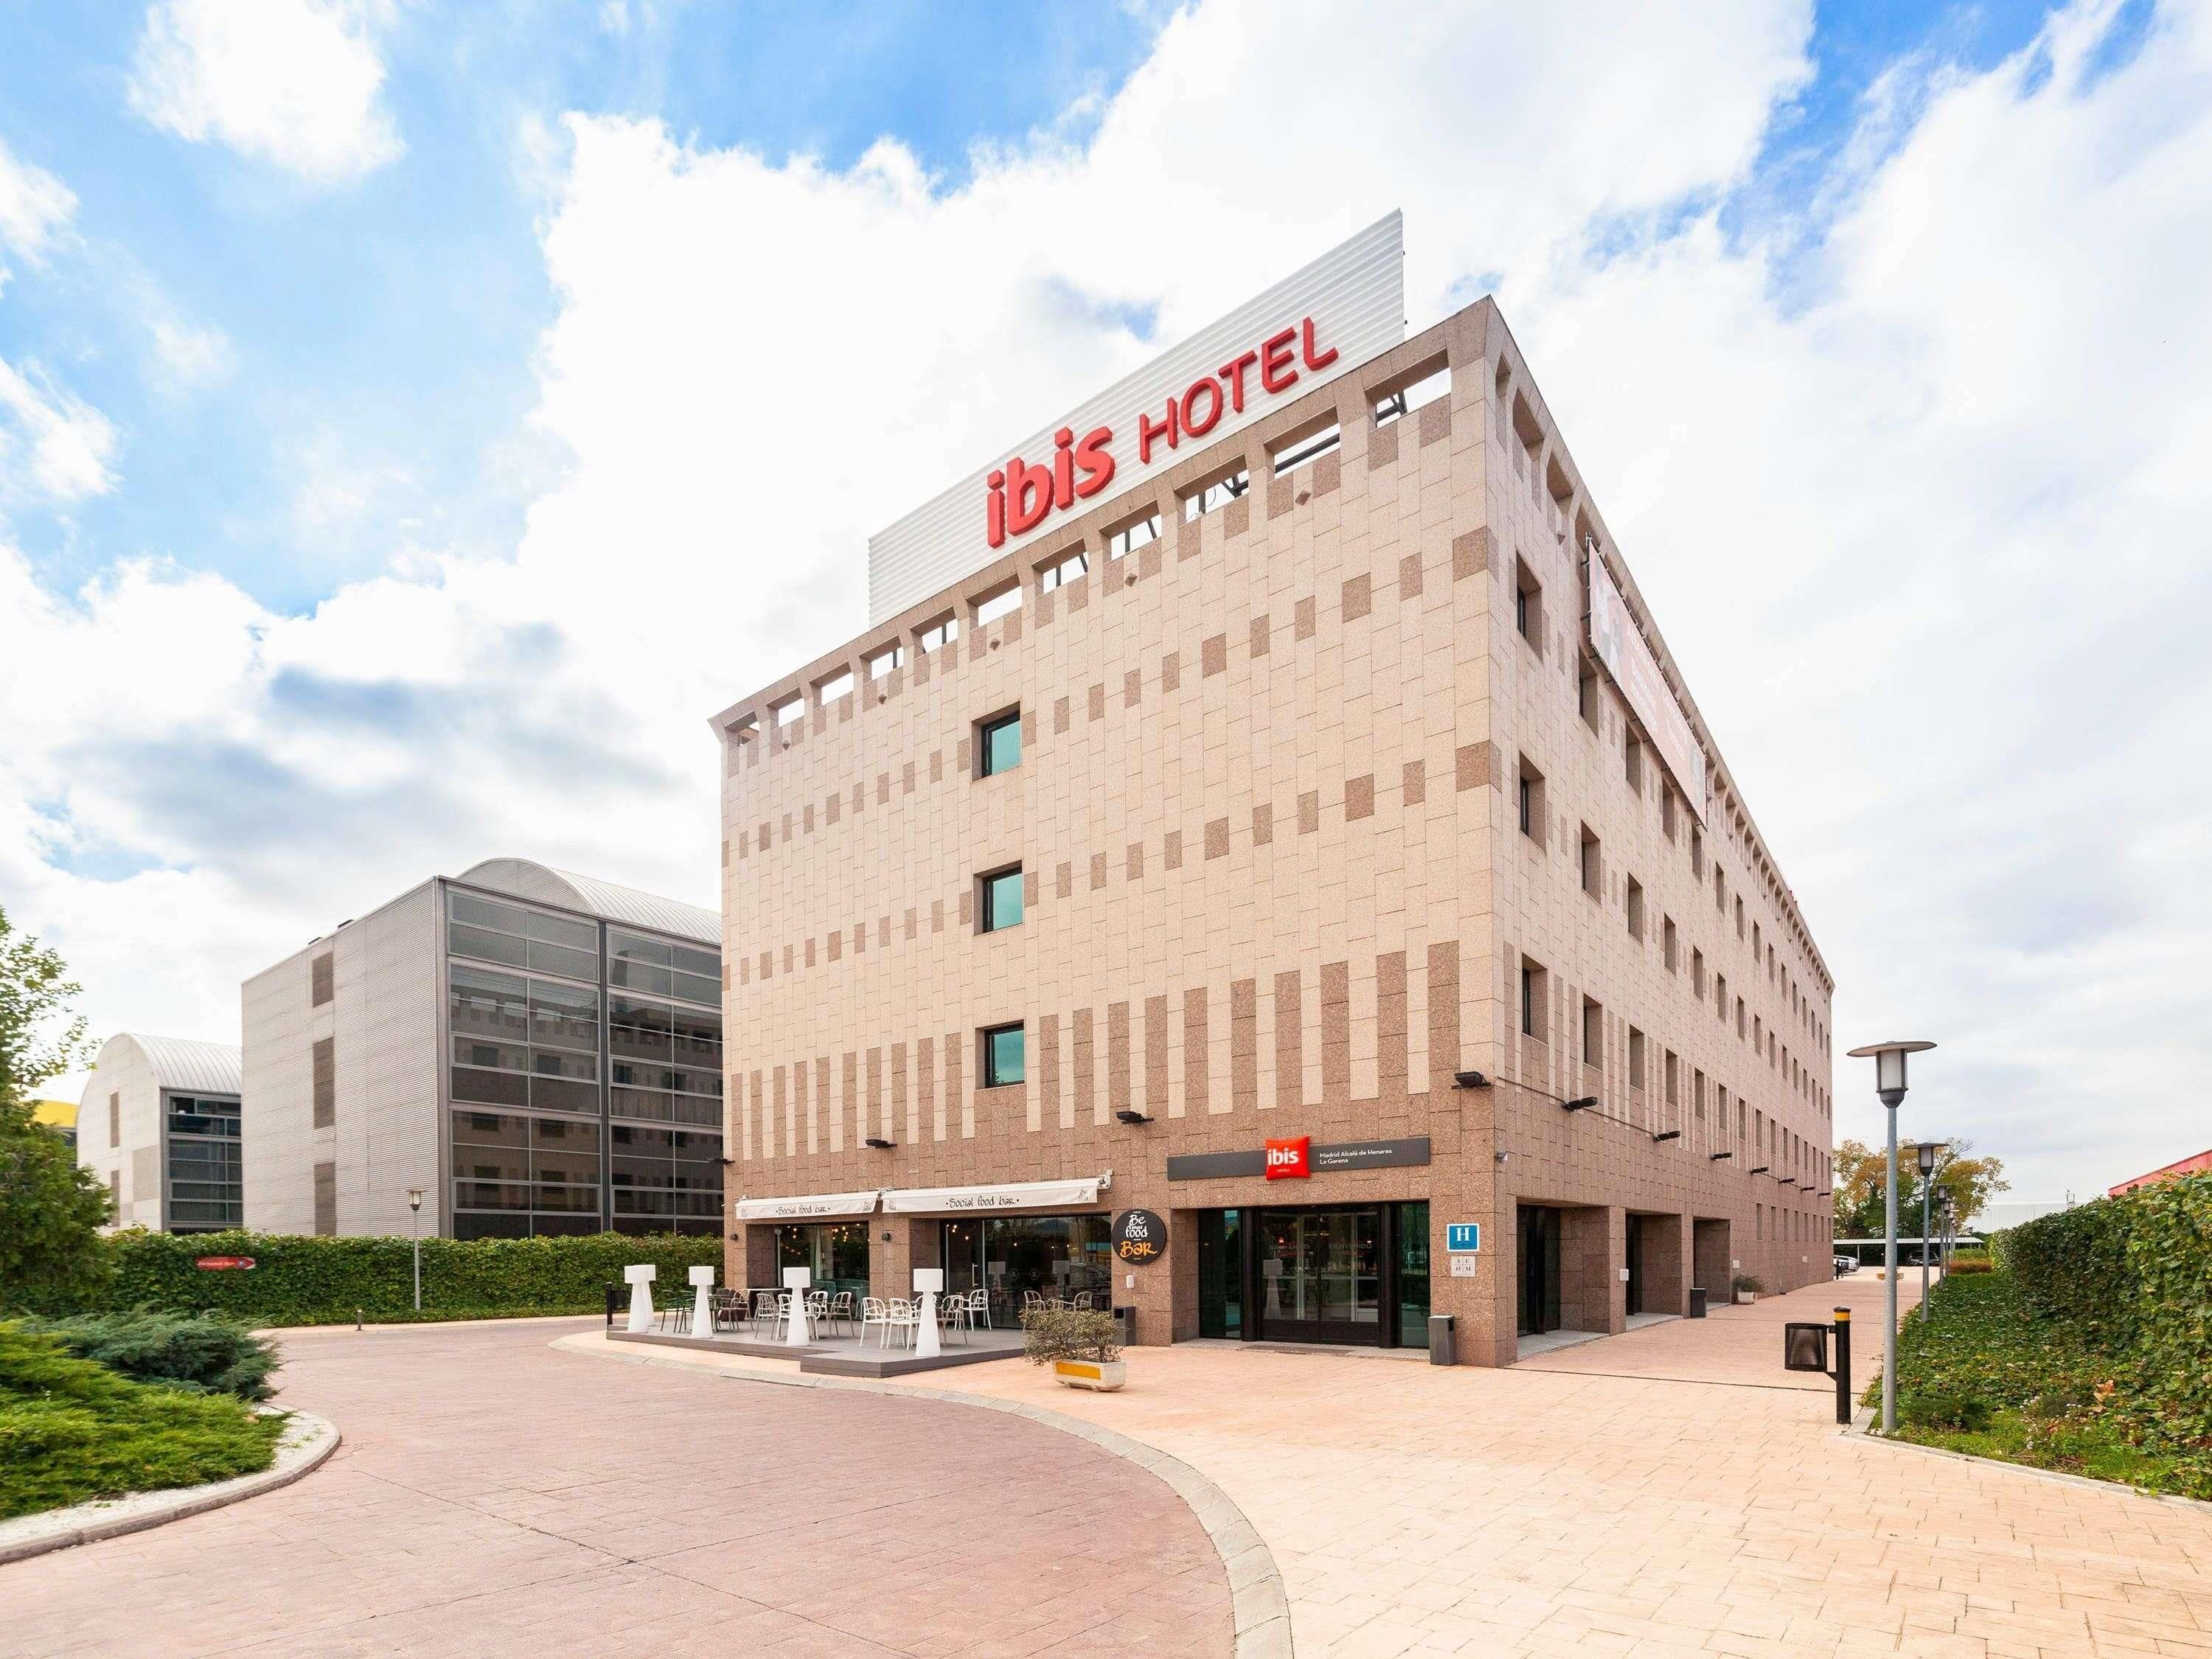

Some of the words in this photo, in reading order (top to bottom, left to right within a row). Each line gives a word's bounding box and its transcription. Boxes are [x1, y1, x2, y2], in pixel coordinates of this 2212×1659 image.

[987, 426, 1116, 549] ibis
[1138, 316, 1339, 465] HOTEL
[1267, 1147, 1299, 1166] ibis
[978, 1195, 995, 1206] food
[1129, 1214, 1146, 1225] Be
[1125, 1225, 1148, 1238] food
[1456, 1226, 1470, 1242] H
